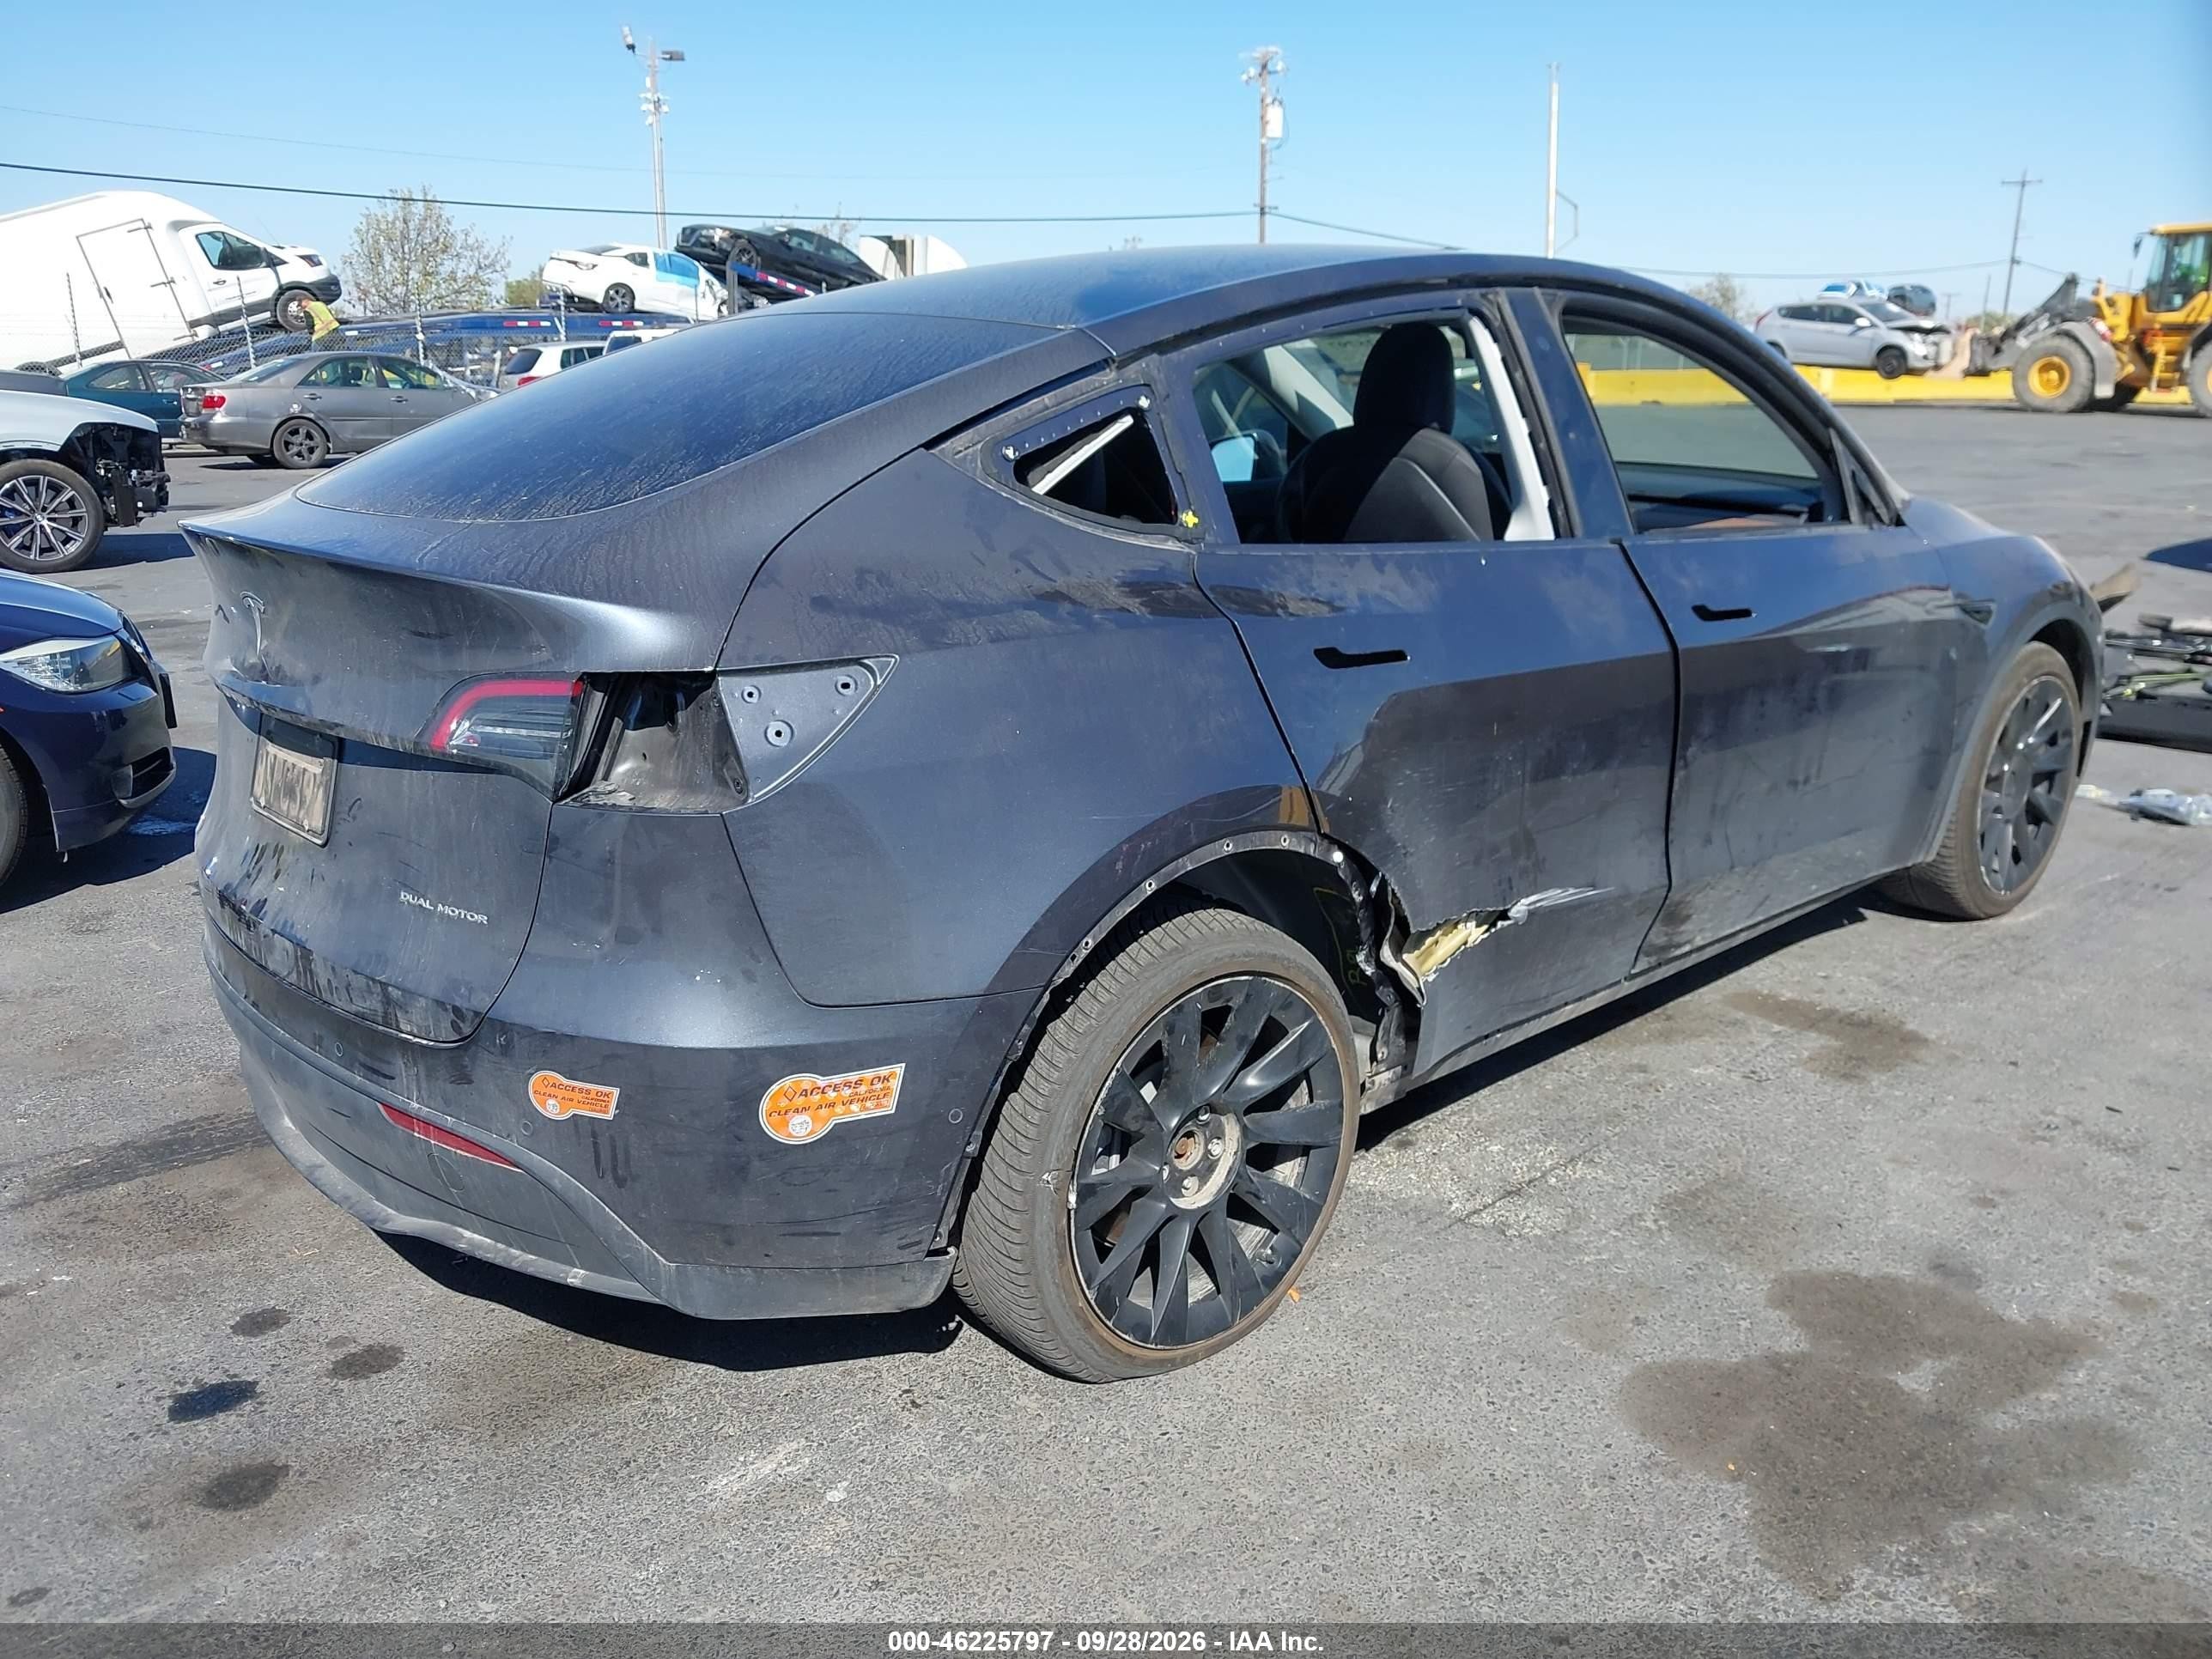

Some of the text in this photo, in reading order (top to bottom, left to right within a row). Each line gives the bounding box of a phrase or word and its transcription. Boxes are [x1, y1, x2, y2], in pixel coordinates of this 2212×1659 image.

[400, 890, 488, 925] DUAL MOTOR
[550, 1082, 611, 1099] ACCESS OK
[798, 1073, 894, 1098] ACCESS OK
[848, 1085, 891, 1098] CALIFORNIA
[534, 1090, 558, 1099] CLEAN
[577, 1099, 610, 1109] VEHICLE
[769, 1105, 811, 1118] CLEAN
[814, 1102, 836, 1111] AIR
[842, 1092, 890, 1107] VEHICLE
